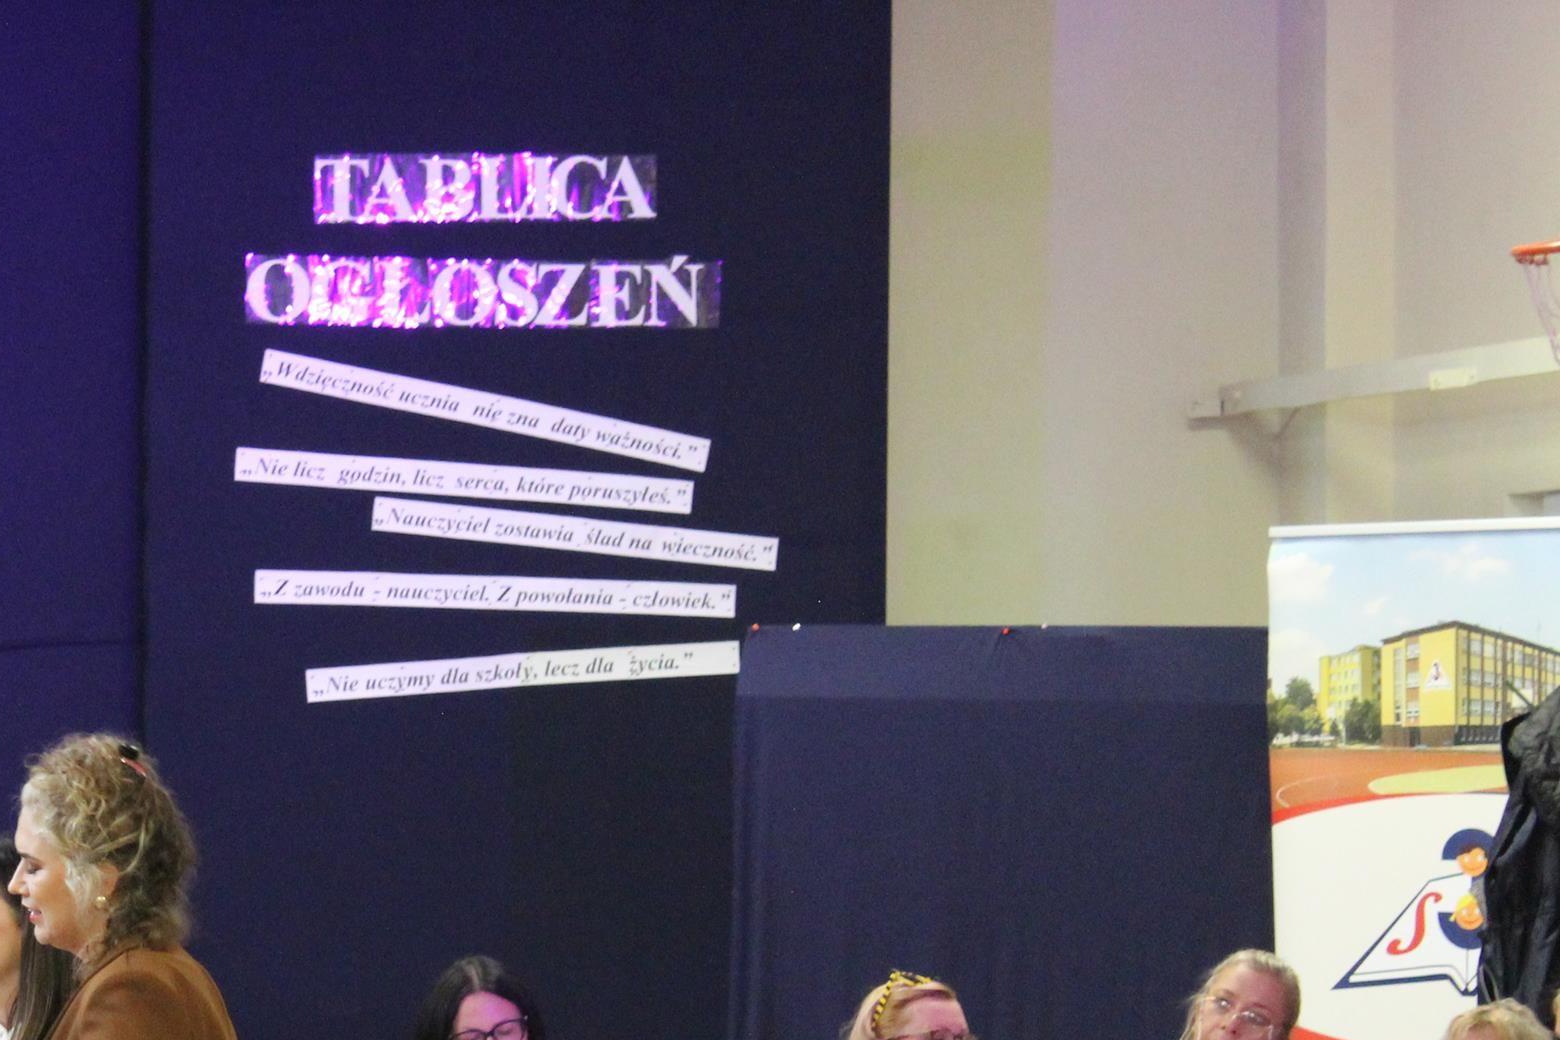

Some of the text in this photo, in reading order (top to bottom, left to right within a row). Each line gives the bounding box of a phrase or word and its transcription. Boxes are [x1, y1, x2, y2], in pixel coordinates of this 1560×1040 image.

[314, 154, 657, 222] TABLICA
[246, 255, 704, 328] OGŁOSZEŃ
[398, 388, 460, 413] ucznia
[472, 402, 503, 421] nie
[506, 409, 540, 428] zna
[551, 417, 590, 442] daty
[293, 460, 326, 479] licz
[412, 468, 445, 489] licz
[516, 475, 564, 496] które
[495, 522, 574, 543] zostawia
[586, 528, 625, 549] ślad
[628, 539, 653, 551] na
[294, 581, 366, 598] zawodu
[496, 585, 513, 602] Z
[515, 588, 614, 607] powołania
[365, 674, 436, 692] uczymy
[440, 667, 469, 686] dla
[544, 661, 579, 678] lecz
[585, 658, 614, 675] dla
